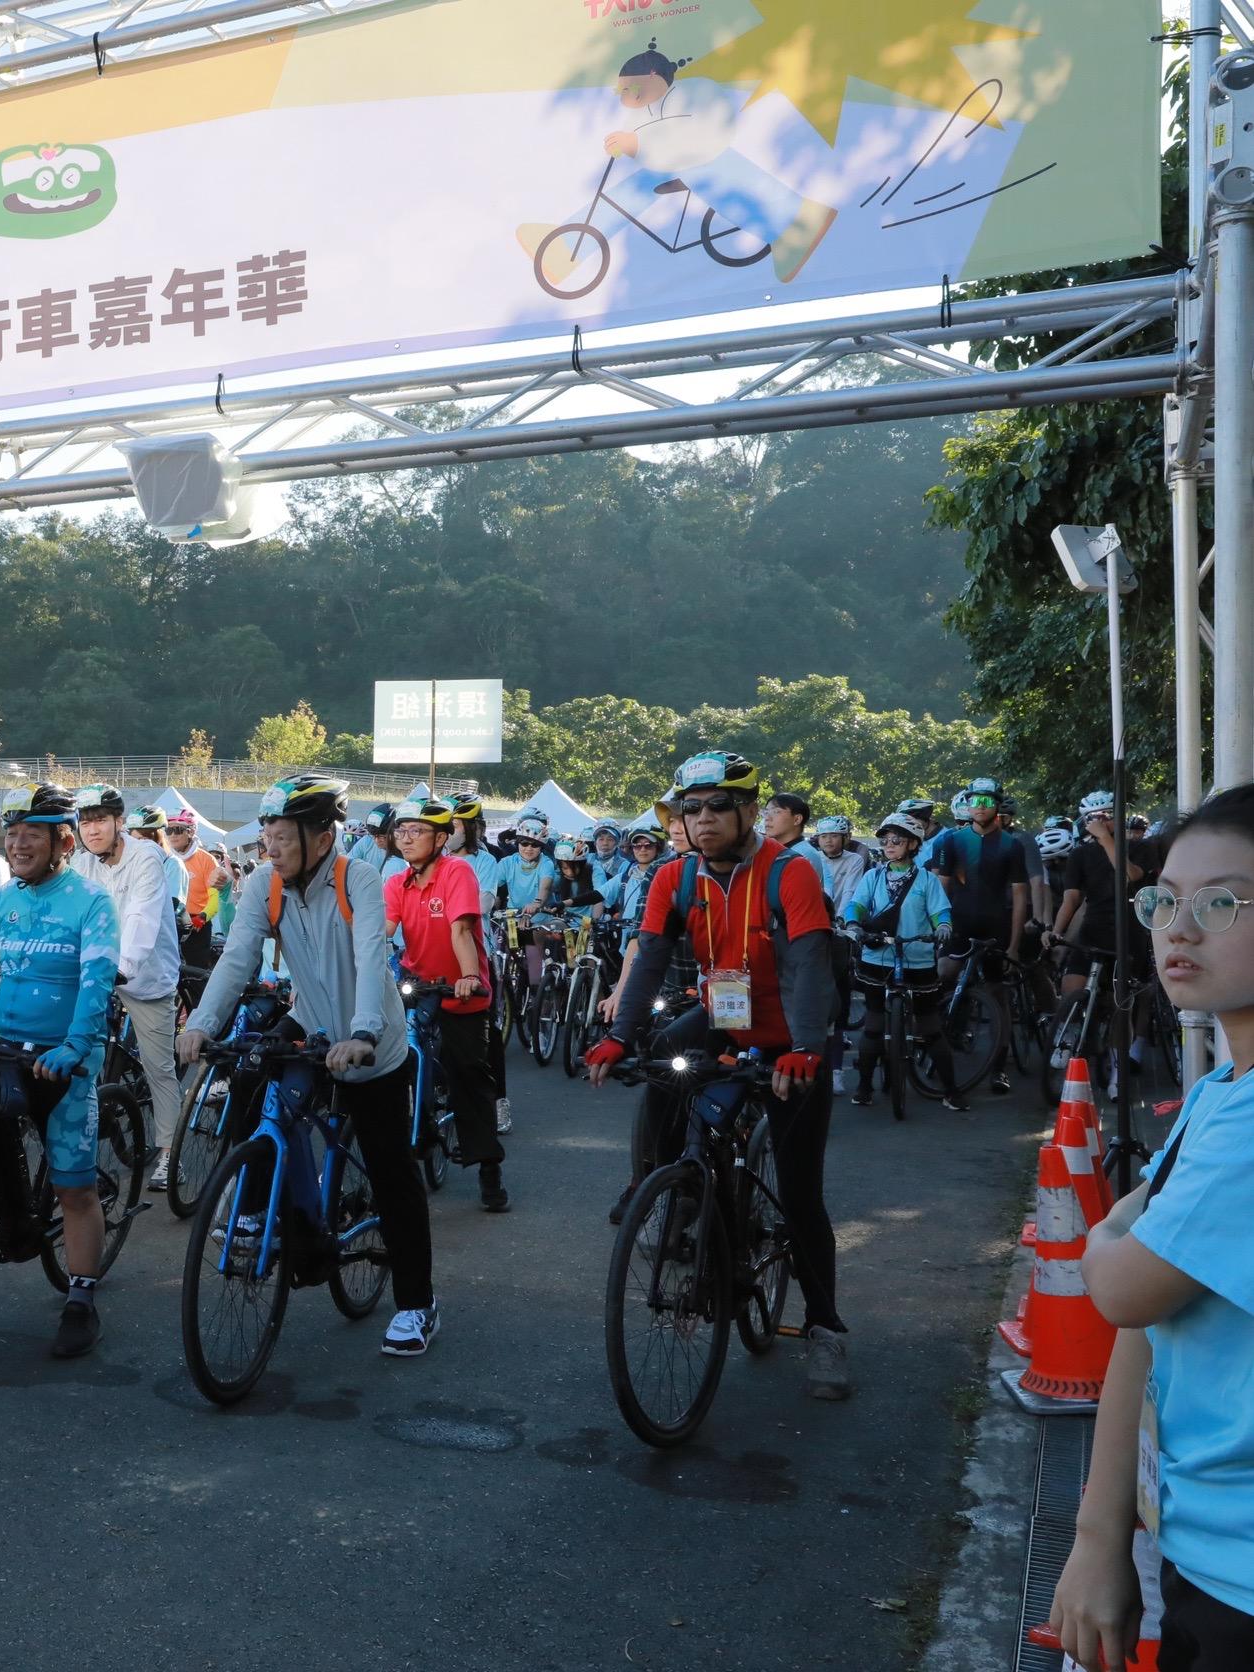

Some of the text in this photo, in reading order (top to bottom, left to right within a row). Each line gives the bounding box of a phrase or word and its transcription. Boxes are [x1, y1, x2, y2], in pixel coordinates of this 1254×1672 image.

[612, 15, 644, 27] WAVES
[645, 13, 659, 22] OF
[660, 4, 701, 18] WONDER
